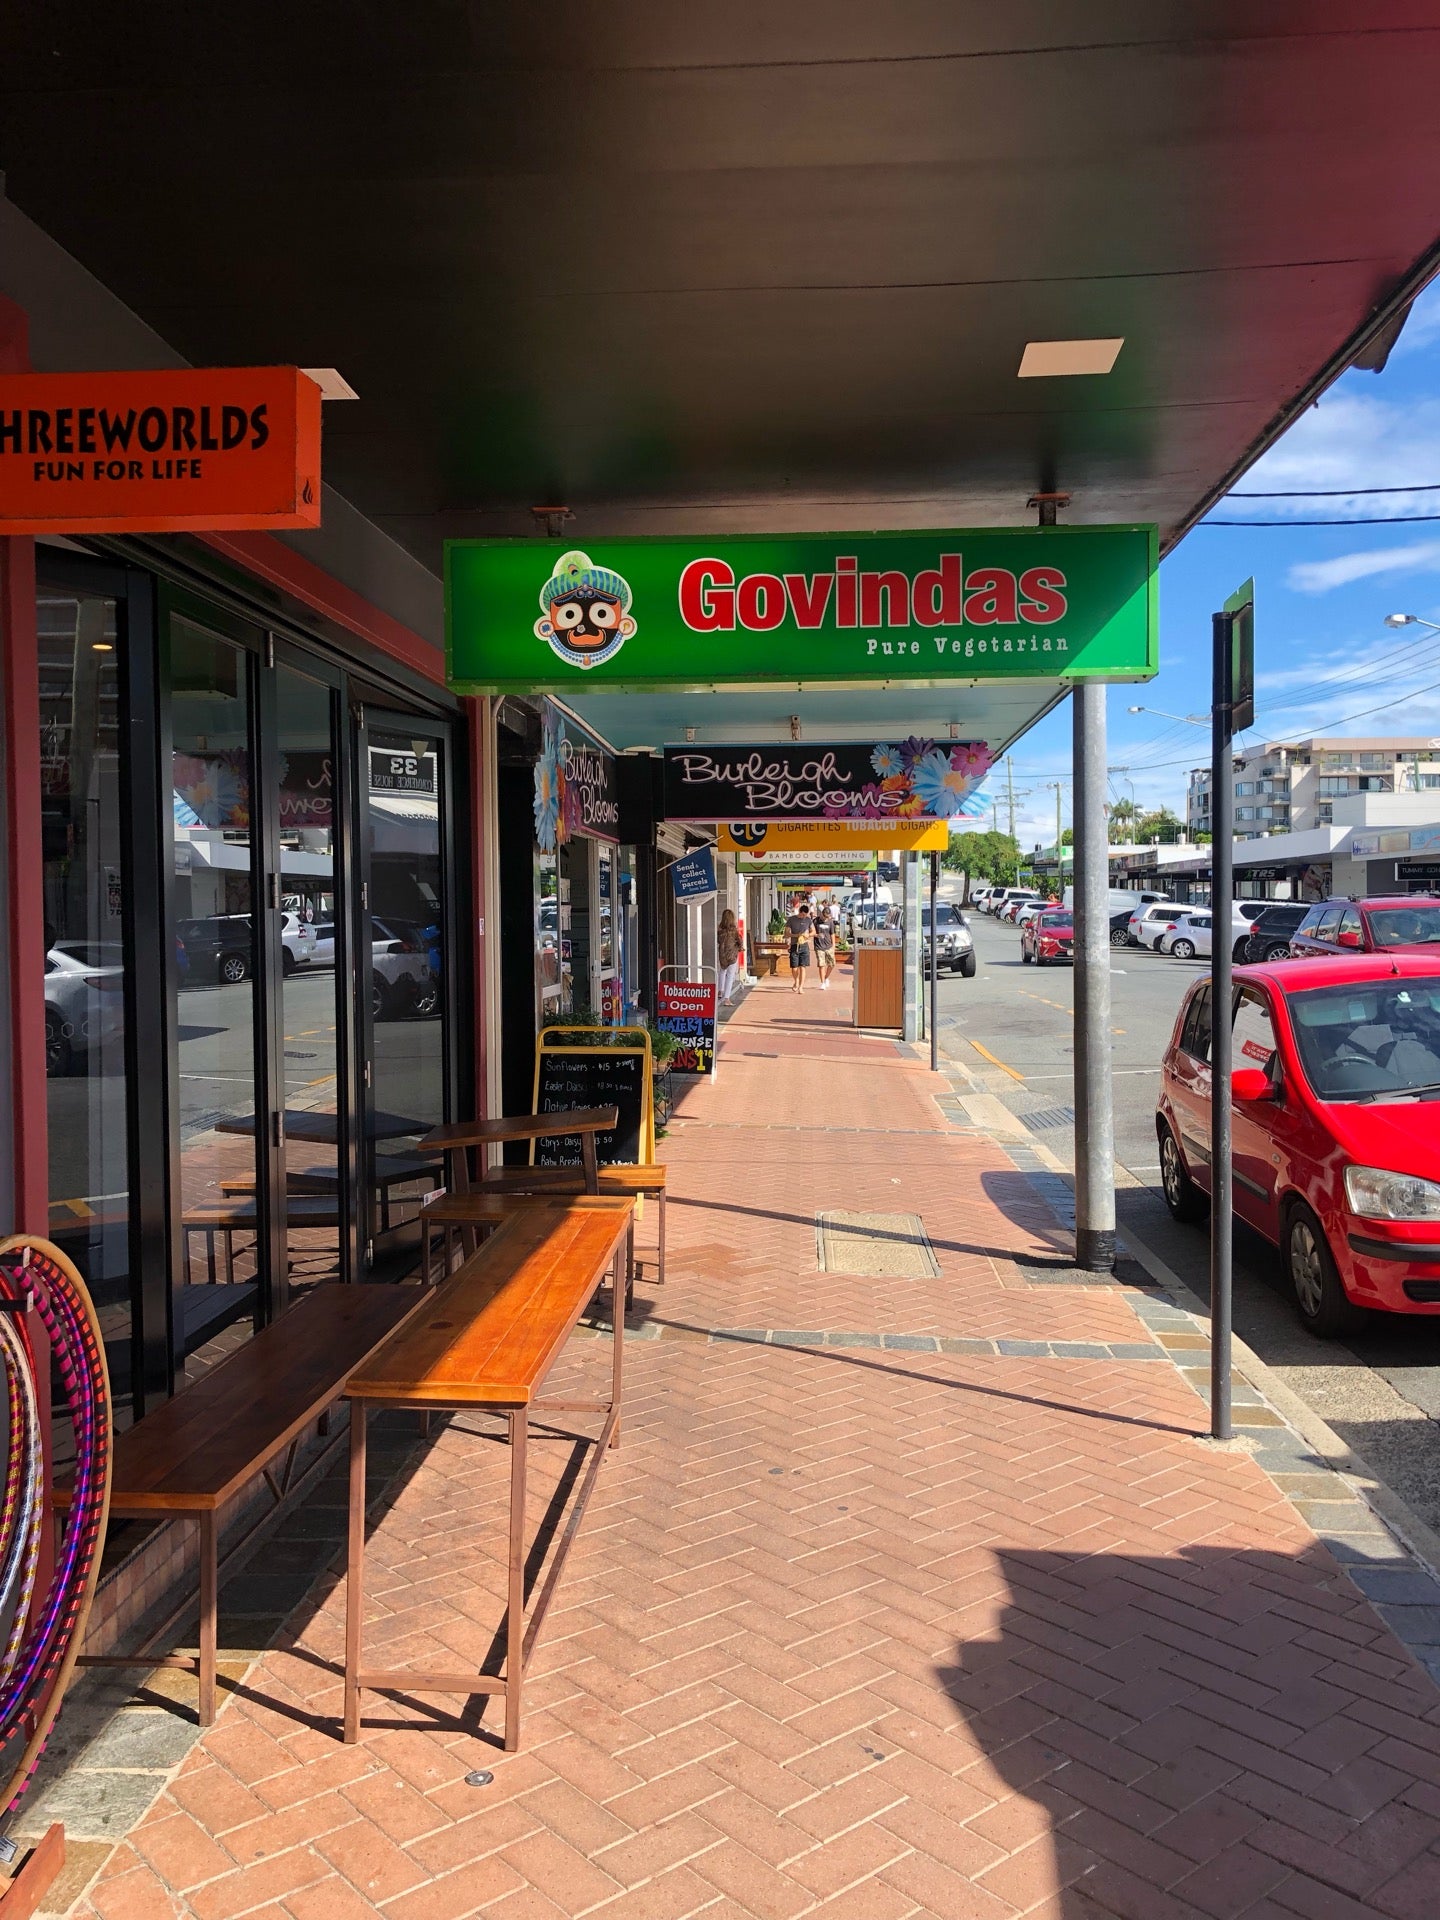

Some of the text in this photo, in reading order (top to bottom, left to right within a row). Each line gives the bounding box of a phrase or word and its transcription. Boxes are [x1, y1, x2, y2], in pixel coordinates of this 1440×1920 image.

[34, 459, 203, 482] FUN FOR LIFE
[678, 553, 1068, 632] Govindas
[866, 634, 1069, 657] Pure Vegetarian
[560, 739, 608, 800] Burleigh
[671, 752, 852, 791] Burleigh
[735, 781, 907, 810] Blooms
[579, 784, 619, 824] Blooms
[777, 820, 939, 832] CIGARETTES TOBACCO CIGARS
[676, 861, 695, 872] Send
[1252, 869, 1276, 878] TRS
[681, 869, 707, 879] collect
[681, 877, 708, 890] parcels
[663, 984, 711, 998] Tobacconist
[669, 1000, 704, 1012] Open
[545, 1060, 588, 1072] Sunflowers
